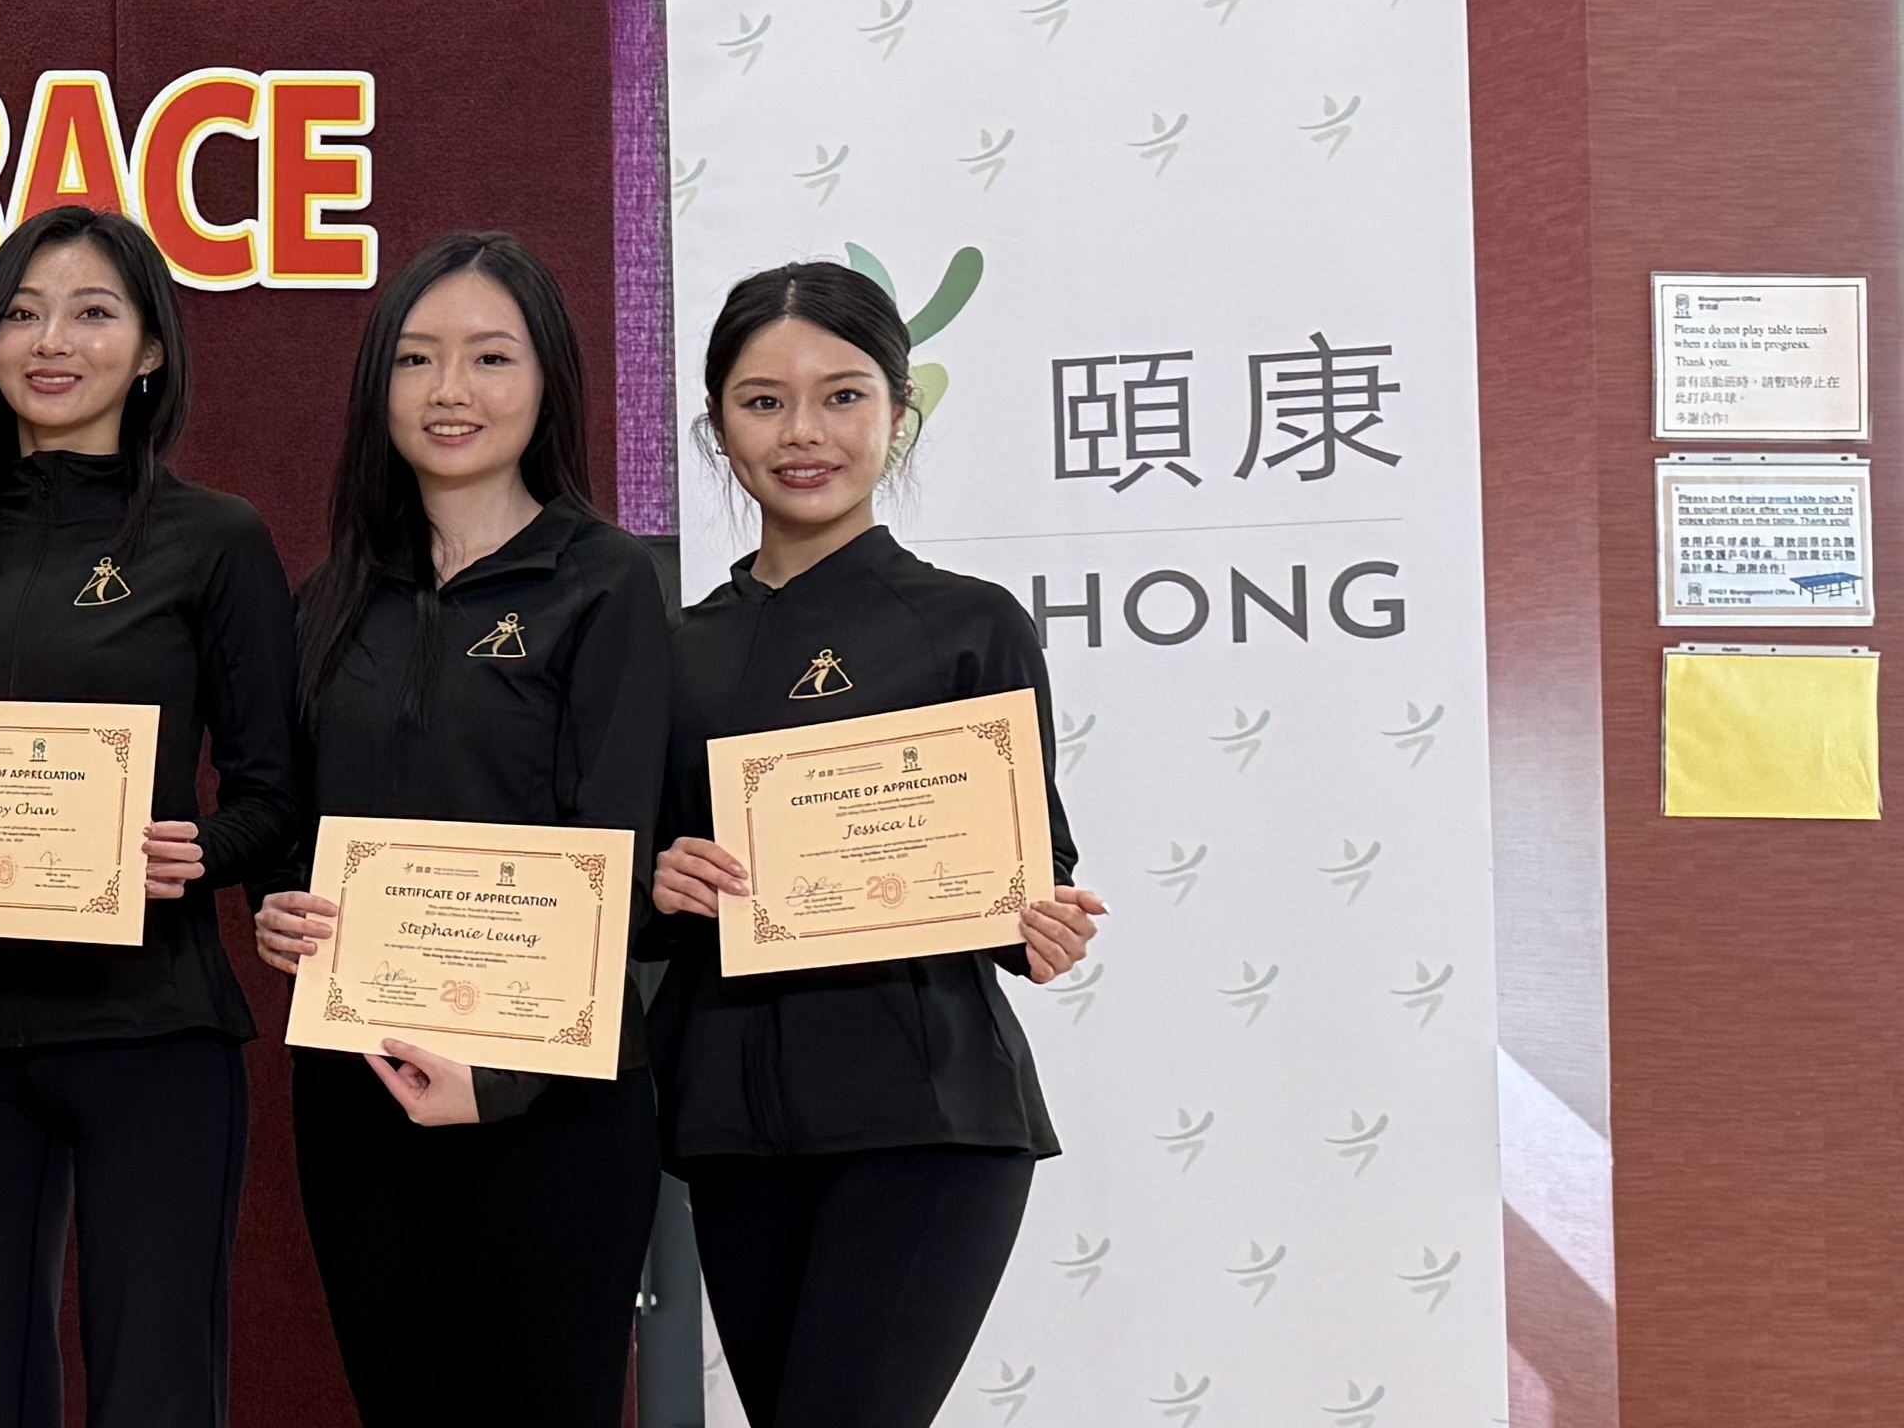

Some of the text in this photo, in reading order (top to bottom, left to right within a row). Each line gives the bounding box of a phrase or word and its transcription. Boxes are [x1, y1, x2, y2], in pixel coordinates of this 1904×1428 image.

[1675, 325, 1827, 337] Please do not play table tennis
[1675, 340, 1700, 349] when
[1704, 341, 1709, 349] a
[1712, 340, 1737, 349] class
[1740, 340, 1748, 349] is
[1752, 340, 1761, 349] in
[1676, 356, 1705, 367] Thank
[1051, 331, 1402, 494] 頤康
[1032, 560, 1406, 650] HONG
[10, 769, 85, 782] APPRECIATION
[791, 788, 861, 806] CERTIFICATE
[864, 785, 880, 797] OF
[883, 772, 968, 794] APPRECIATION
[15, 802, 59, 817] Chan
[841, 814, 928, 840] Jessica Li
[385, 885, 558, 908] CERTIFICATE OF APPRECIATION
[398, 921, 542, 947] Stephanie Leung
